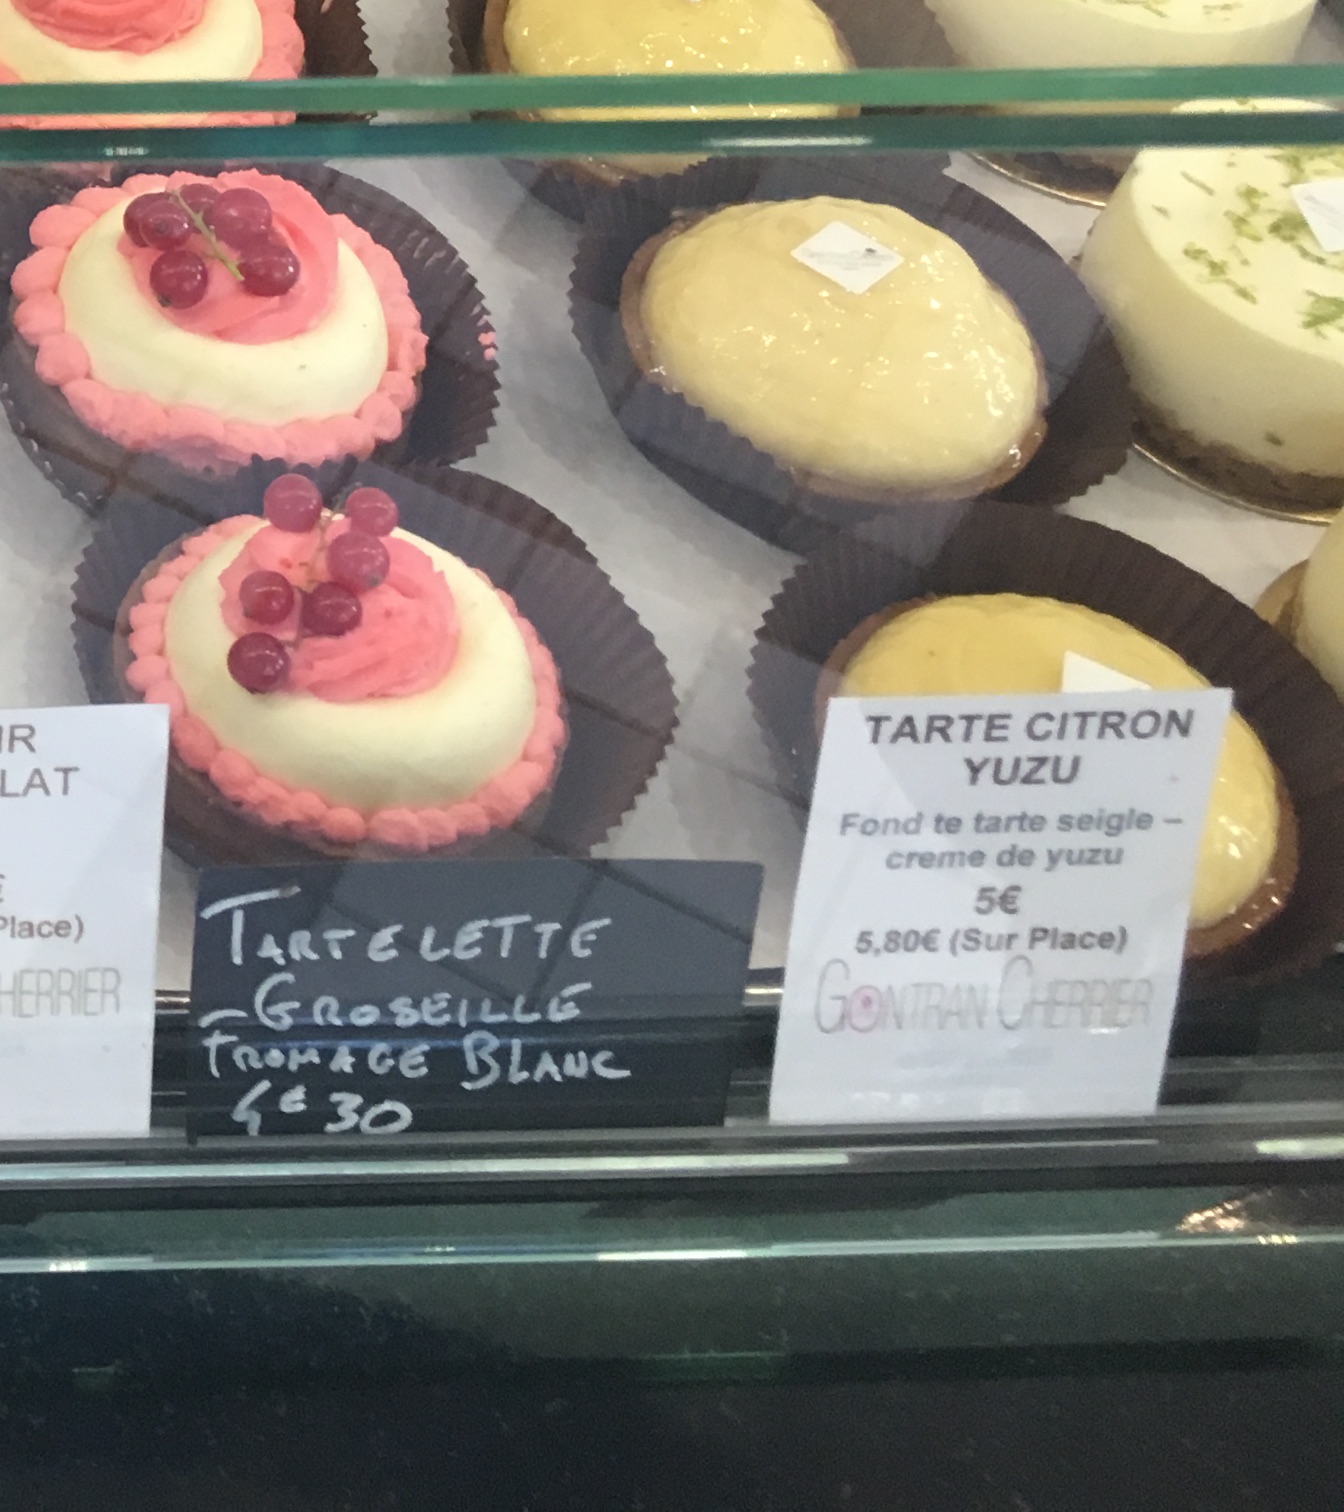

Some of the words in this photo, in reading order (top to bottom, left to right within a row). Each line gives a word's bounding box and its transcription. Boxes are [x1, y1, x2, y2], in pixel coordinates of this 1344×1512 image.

[867, 714, 1012, 744] TARTE
[1026, 710, 1193, 742] CITRON
[965, 756, 1080, 786] YUZU
[840, 811, 924, 837] Fond
[974, 812, 1047, 833] tarte
[1057, 807, 1154, 837] seigle
[886, 849, 988, 870] creme
[996, 844, 1036, 868] de
[1045, 848, 1124, 872] yuzu
[976, 884, 1022, 915] 5€
[201, 887, 611, 966] TARTELETTE
[856, 928, 940, 956] 5,80€
[950, 928, 1019, 956] (Sur
[1029, 926, 1128, 954] Place)
[255, 972, 592, 1030] GROSEILLE
[461, 1031, 631, 1091] BLANC
